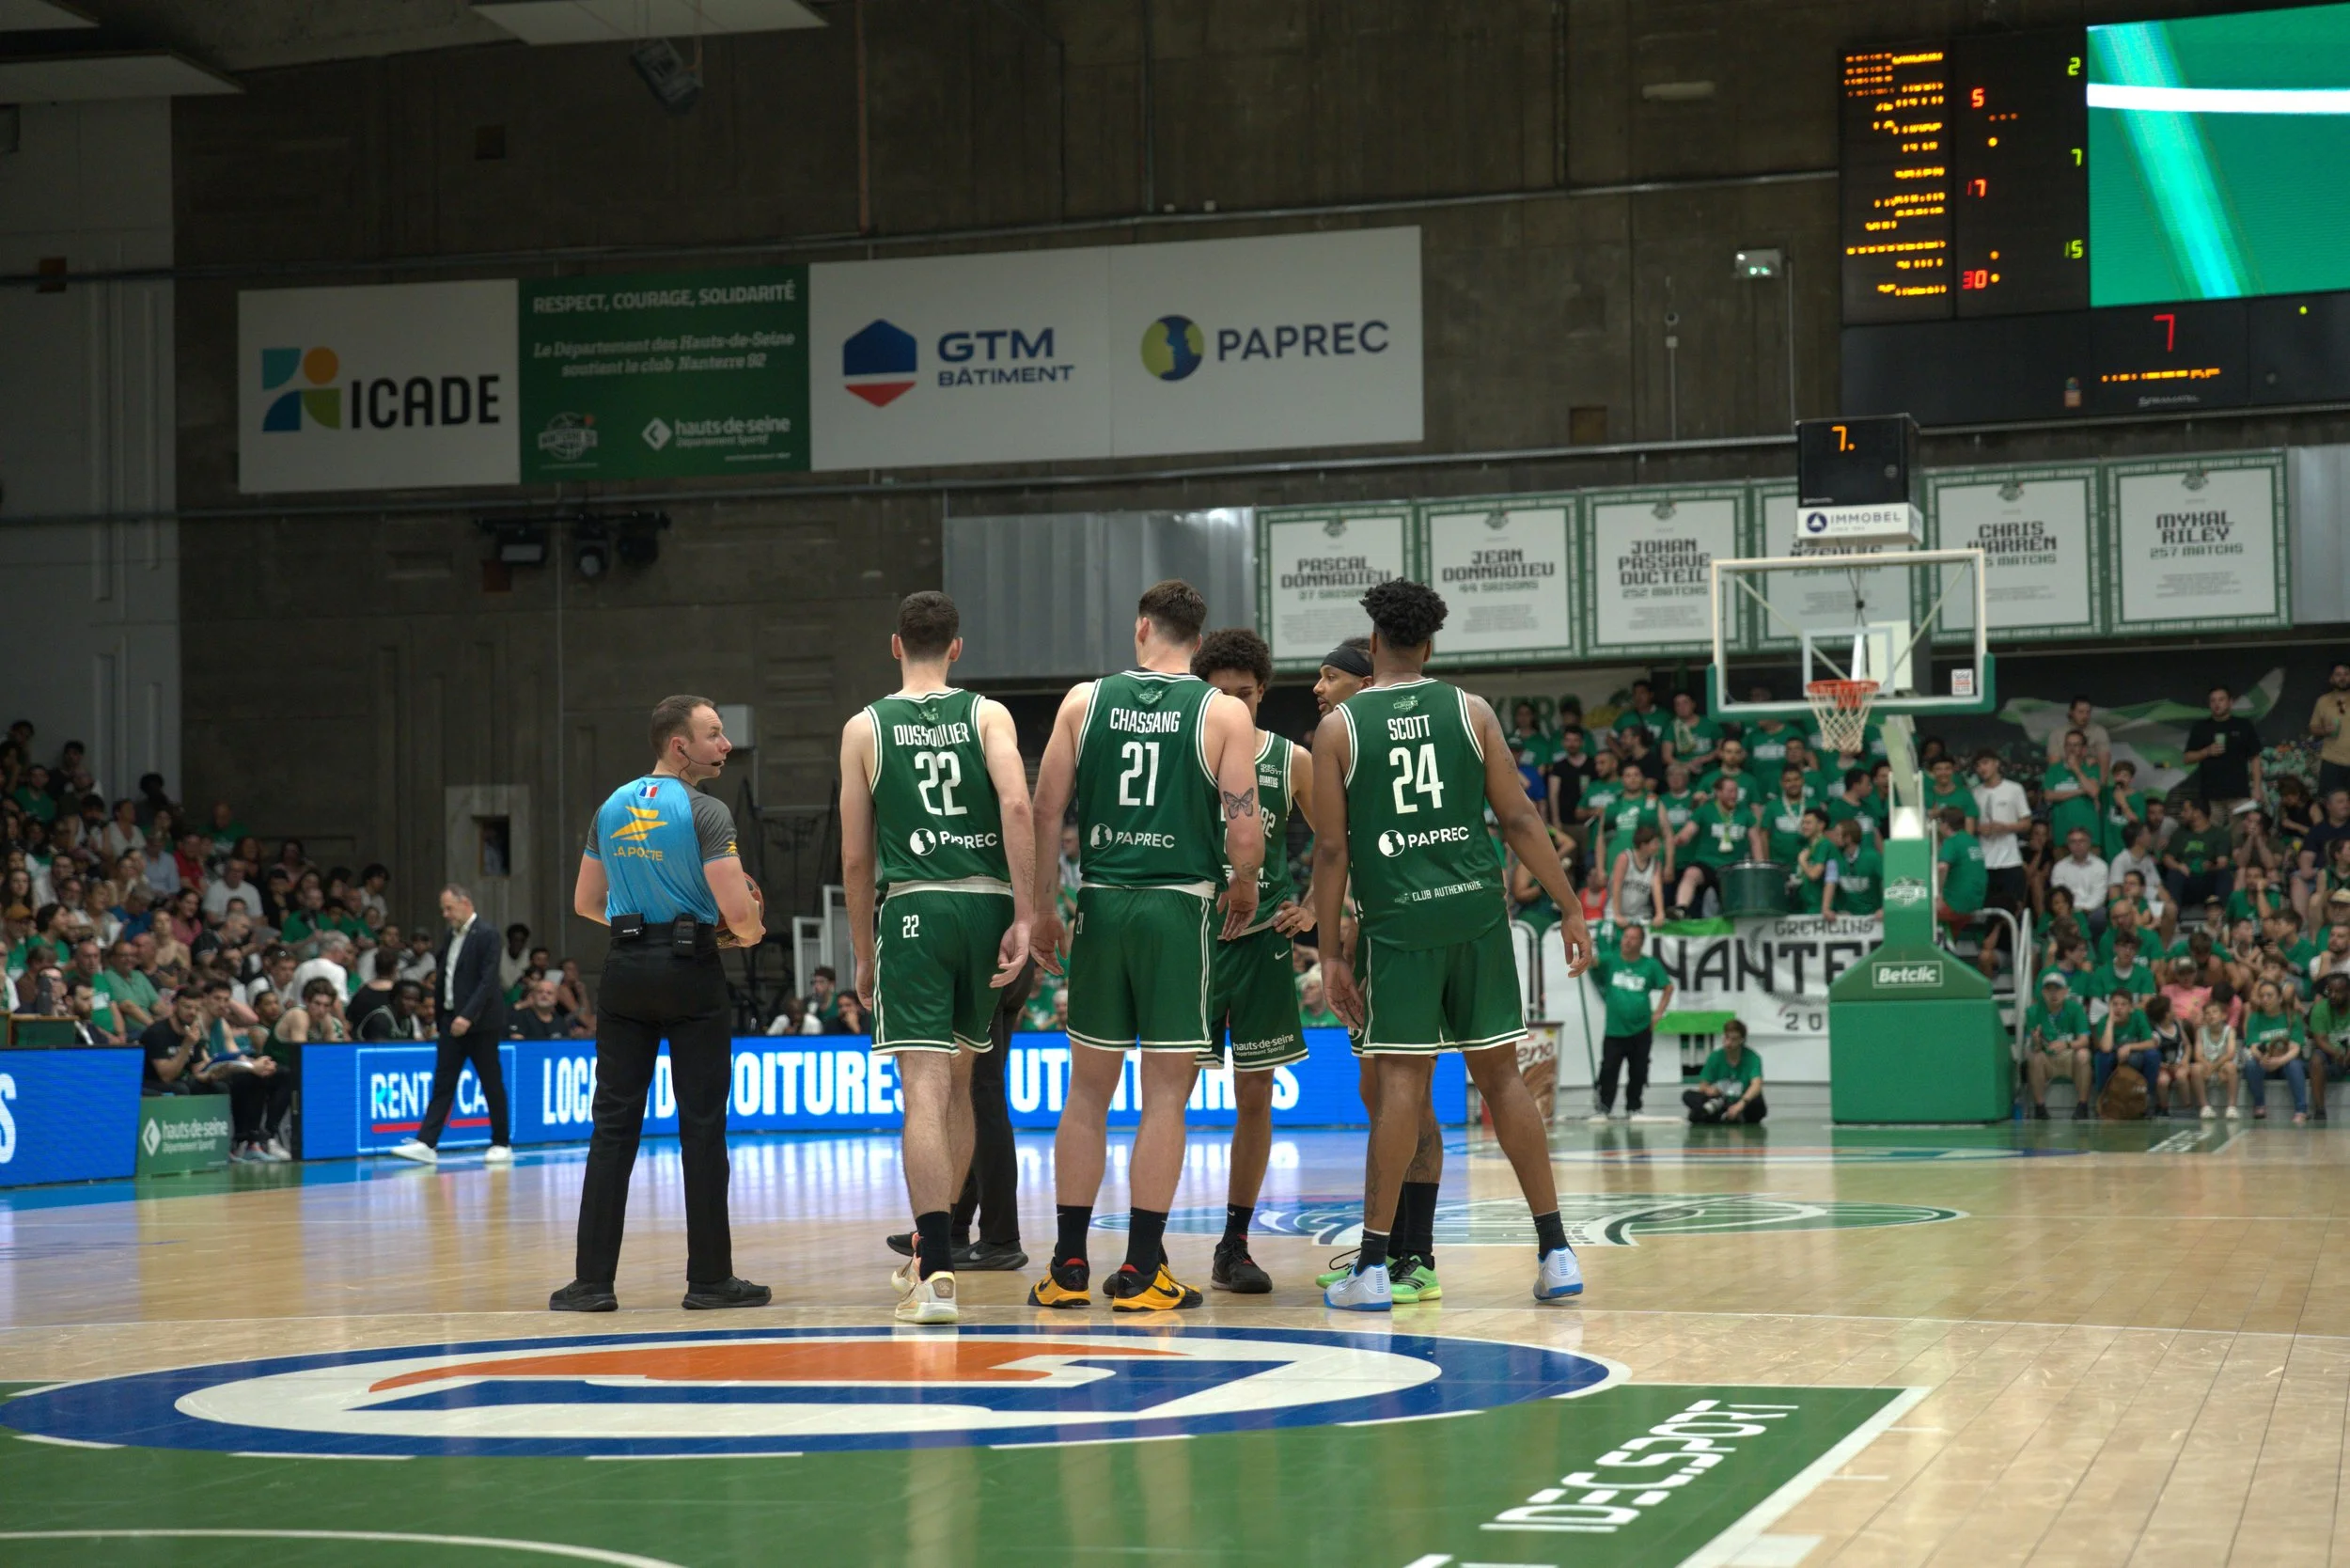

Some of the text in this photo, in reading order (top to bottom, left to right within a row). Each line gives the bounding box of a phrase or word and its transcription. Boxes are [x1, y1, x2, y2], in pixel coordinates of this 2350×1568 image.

[2067, 56, 2081, 76] 2
[1970, 86, 1985, 109] 5
[2071, 148, 2083, 167] 7
[1963, 269, 1988, 290] 30
[533, 279, 796, 314] RESPECT, COURAGE, SOLIDARITÉ
[938, 326, 1056, 363] GTM
[1217, 319, 1389, 362] PAPREC
[2153, 313, 2175, 353] 7
[938, 364, 1074, 388] BÂTIMENT
[352, 374, 500, 430] ICADE
[1829, 510, 1903, 525] IMMOBEL
[2155, 510, 2234, 529] MYKAL
[1978, 521, 2046, 539] CHRIS
[2161, 525, 2231, 545] RILEY
[1471, 548, 1524, 566] JEAN
[1631, 537, 1698, 555] JOHAN
[1620, 566, 1709, 587] DUCTEIL
[1109, 707, 1182, 734] CHASSANG
[1386, 713, 1431, 742] SCOTT
[893, 721, 971, 748] DUSSOULIER
[914, 750, 968, 816] 22
[1119, 741, 1161, 807] 21
[1388, 742, 1445, 814] 24
[1115, 830, 1176, 850] PAPREC
[1407, 825, 1470, 849] PAPREC
[1411, 880, 1484, 902] CLUB AUTHENTIQUE
[902, 914, 919, 938] 22
[1877, 964, 1938, 984] Betclic
[370, 1071, 432, 1120] RENT
[456, 1069, 490, 1115] CA
[727, 1050, 904, 1117] OITURE
